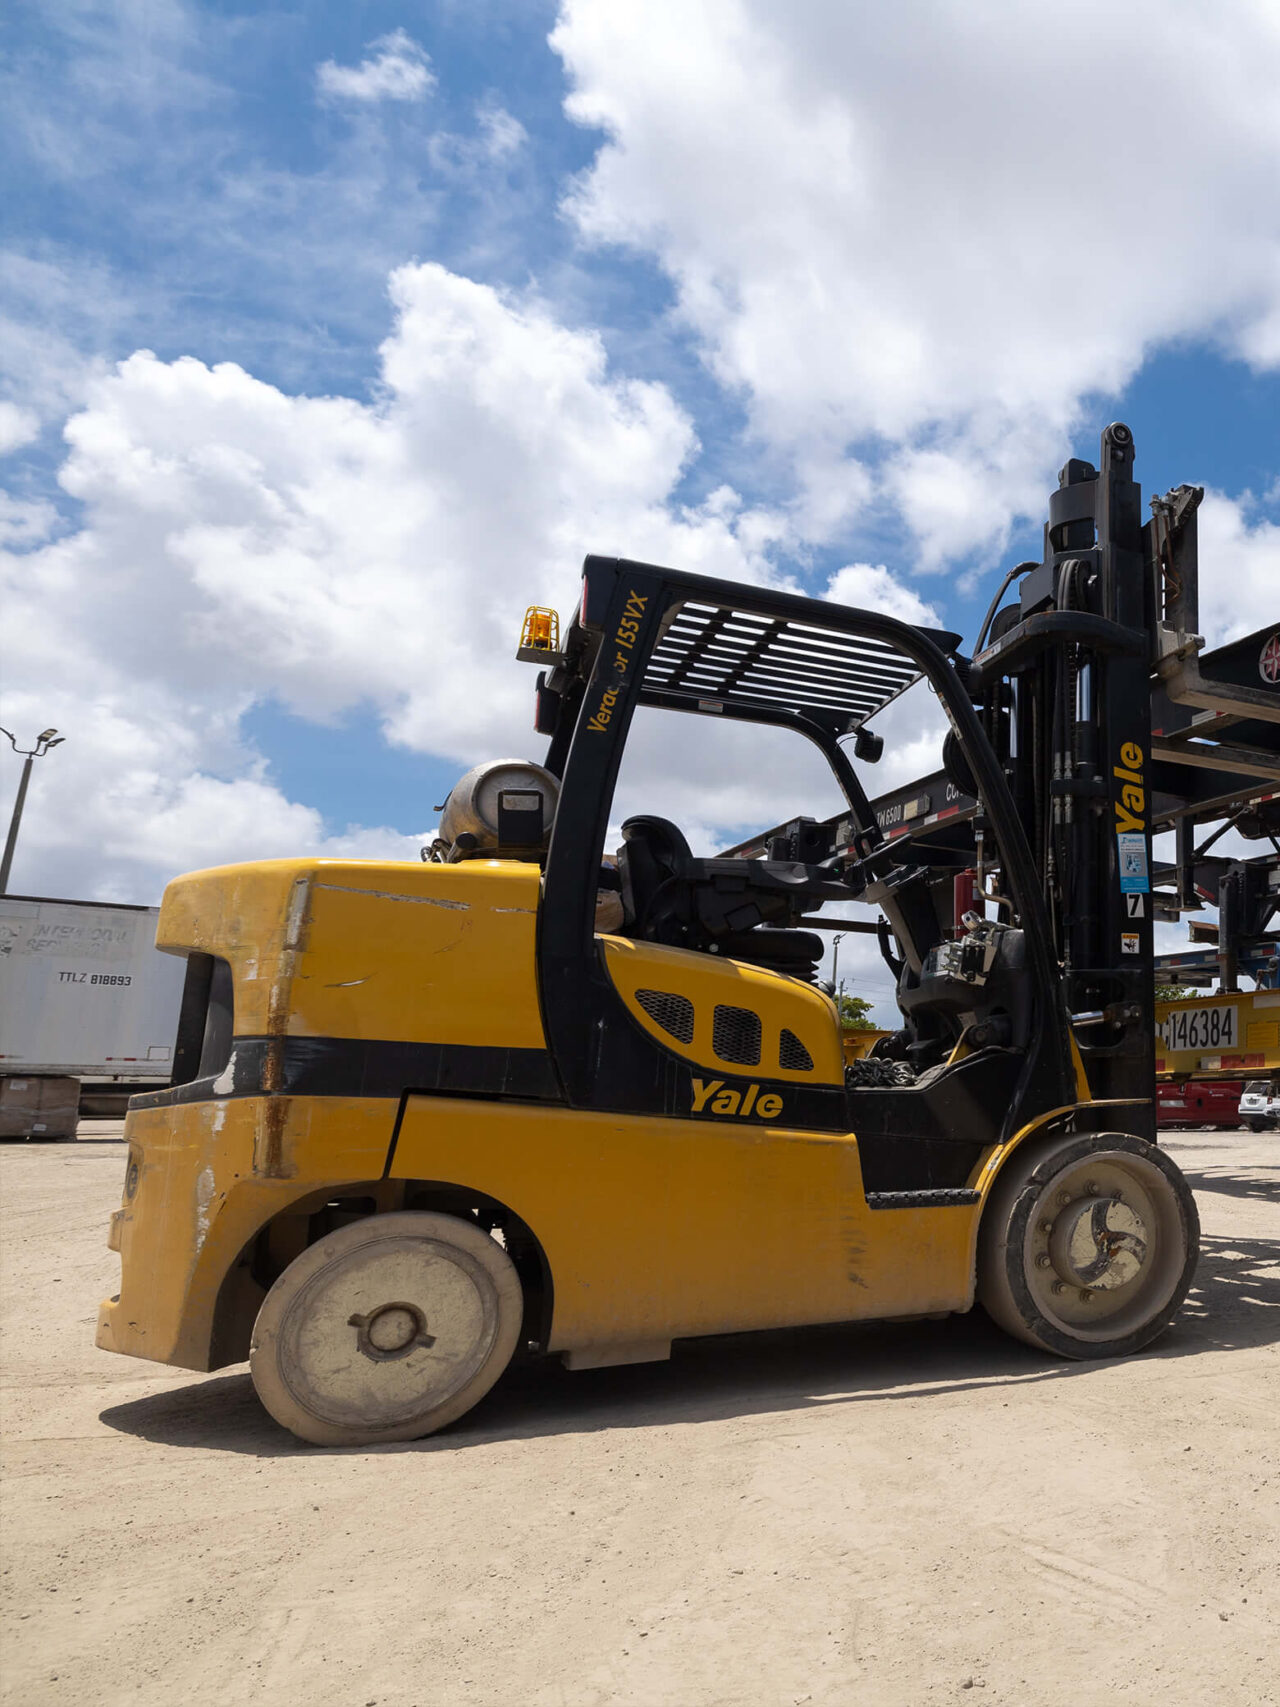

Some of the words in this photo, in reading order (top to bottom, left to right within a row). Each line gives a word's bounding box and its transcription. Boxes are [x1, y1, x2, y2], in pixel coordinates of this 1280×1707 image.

[1113, 741, 1145, 833] Yale
[885, 804, 902, 825] 6500
[1127, 894, 1141, 917] 7
[59, 971, 88, 983] TTLZ
[91, 974, 132, 986] 818893
[1171, 1007, 1233, 1049] 146384
[690, 1078, 784, 1119] Yale
